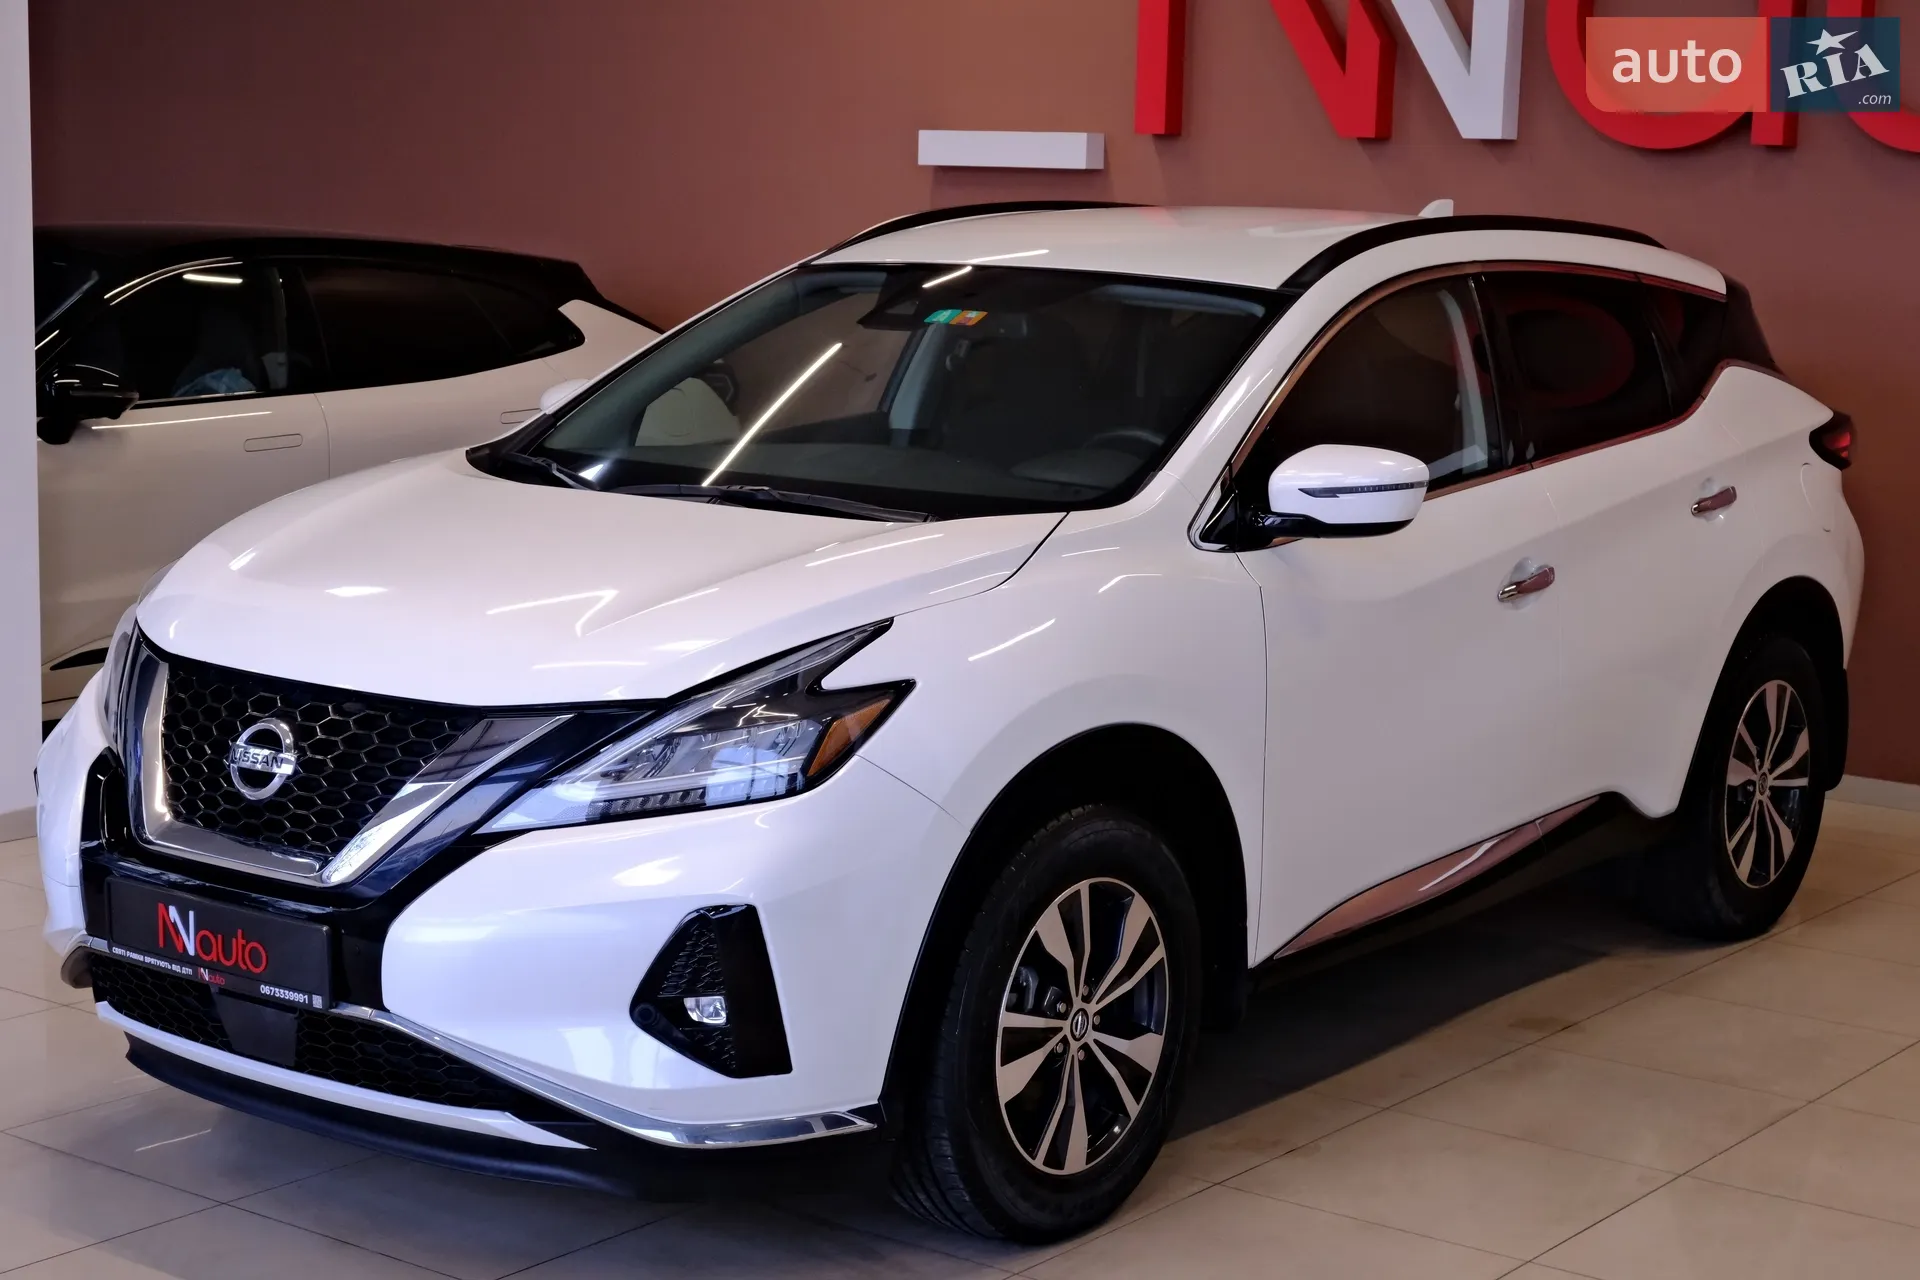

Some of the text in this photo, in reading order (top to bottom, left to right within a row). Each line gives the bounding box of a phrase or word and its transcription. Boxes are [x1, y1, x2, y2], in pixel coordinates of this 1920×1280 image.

[230, 747, 284, 769] NISSAN
[182, 967, 193, 975] ДТП
[260, 984, 309, 1004] 0673339991
